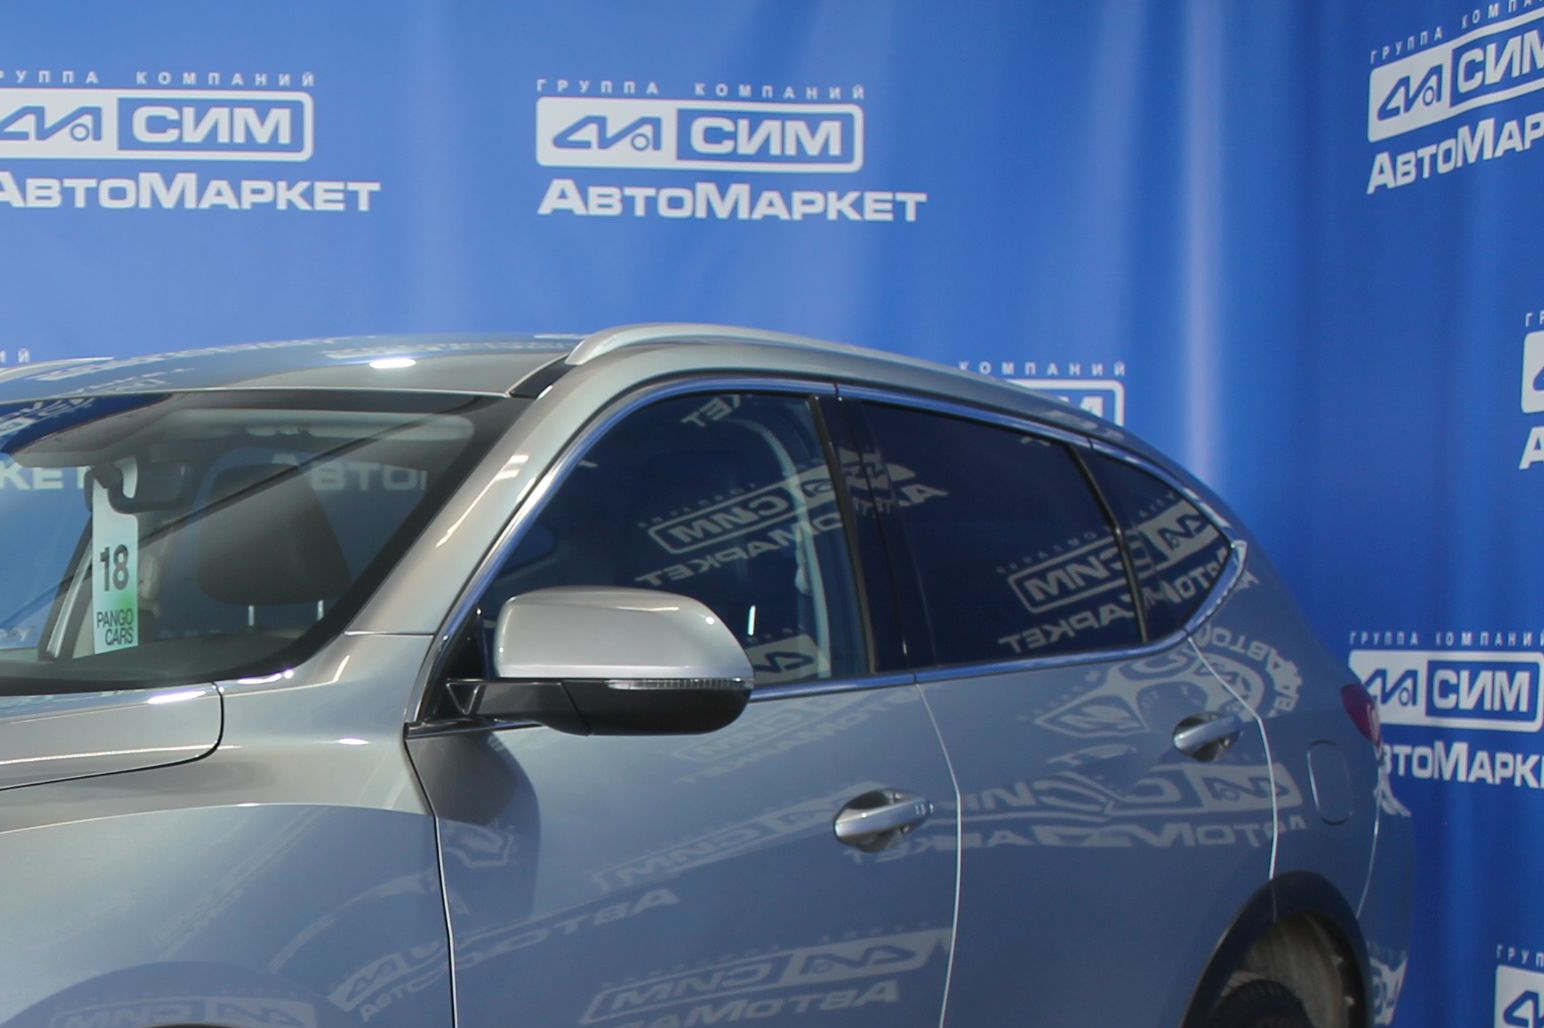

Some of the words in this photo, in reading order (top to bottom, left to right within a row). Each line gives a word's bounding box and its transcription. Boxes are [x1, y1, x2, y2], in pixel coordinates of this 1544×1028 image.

[1370, 27, 1443, 64] ГРУППА
[137, 72, 314, 86] КОМПАНИЙ
[537, 79, 658, 95] ГРУППА
[695, 83, 864, 99] КОМПАНИЙ
[133, 106, 290, 143] СИМ
[691, 116, 841, 156] СИМ
[959, 362, 1125, 377] КОМПАНИЙ
[100, 544, 129, 592] 18
[96, 608, 134, 629] PANGO
[105, 627, 134, 646] CARS
[1350, 631, 1418, 645] ГРУППА
[1434, 670, 1530, 712] СИМ
